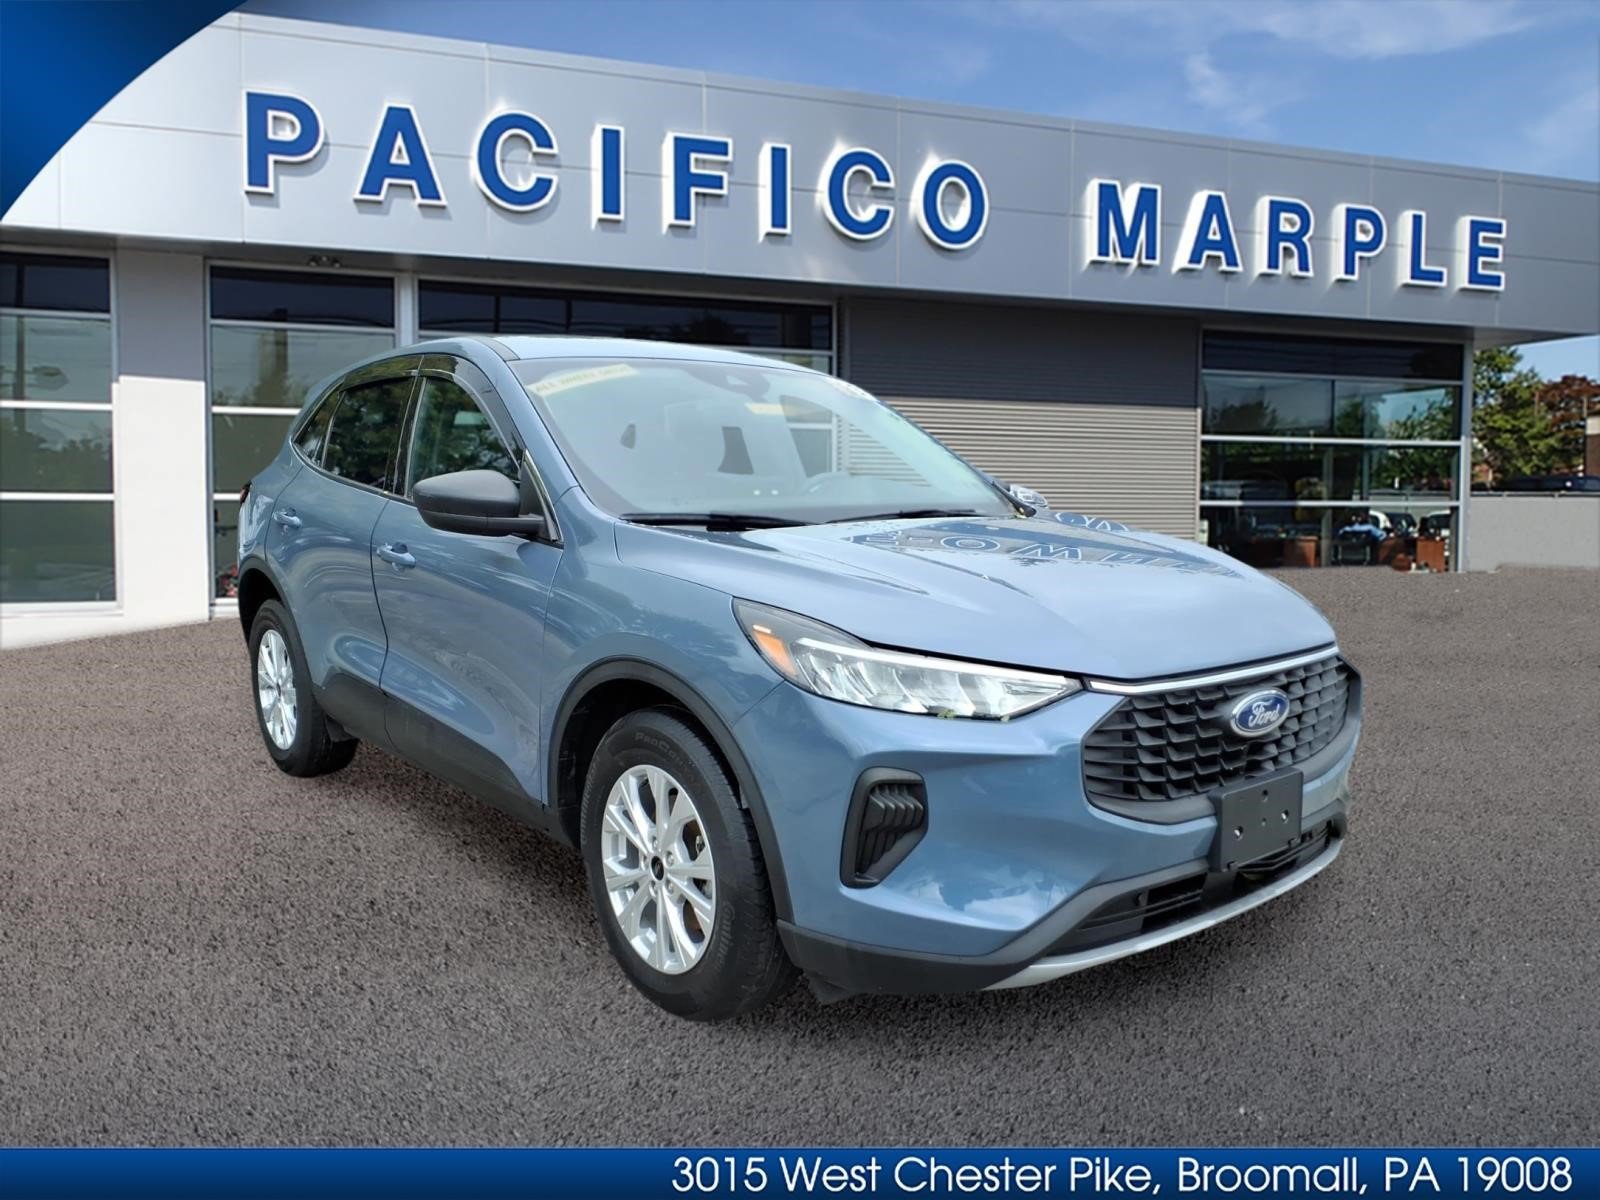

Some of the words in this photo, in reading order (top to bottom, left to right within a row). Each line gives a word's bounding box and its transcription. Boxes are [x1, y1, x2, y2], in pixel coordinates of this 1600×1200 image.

[244, 89, 989, 248] PACIFICO
[1086, 179, 1506, 290] MARPLE
[1248, 700, 1280, 727] Ford
